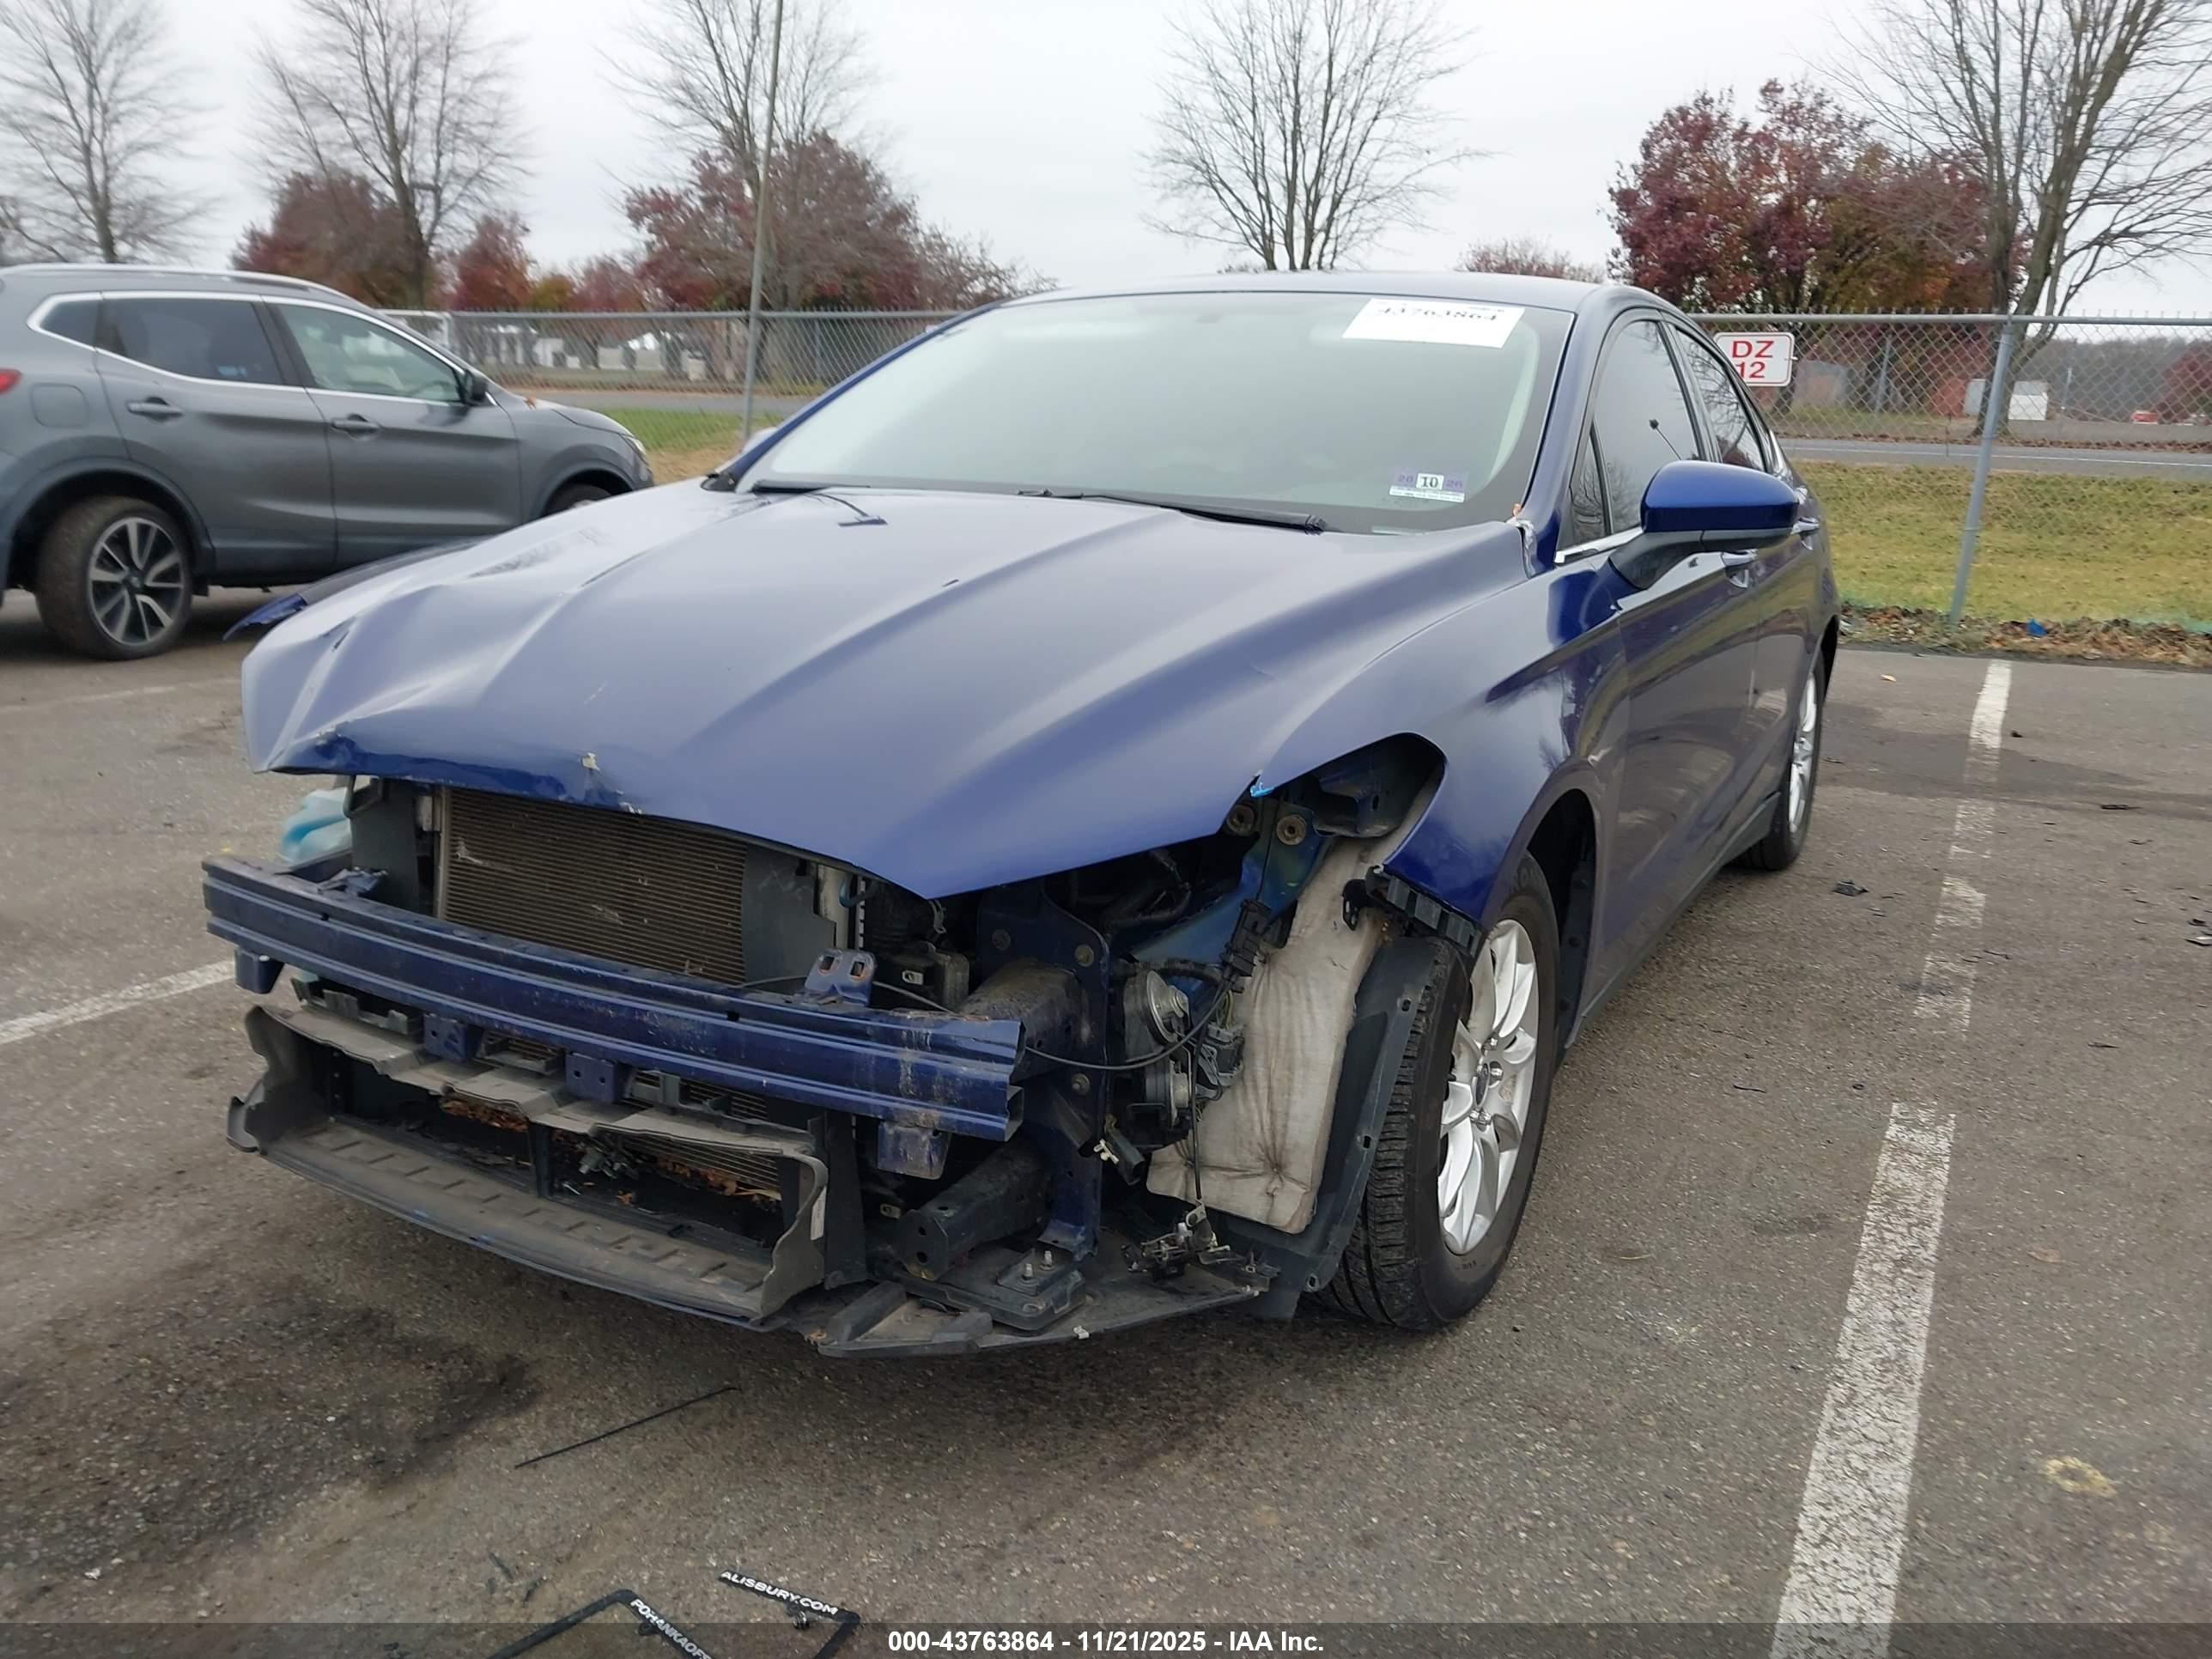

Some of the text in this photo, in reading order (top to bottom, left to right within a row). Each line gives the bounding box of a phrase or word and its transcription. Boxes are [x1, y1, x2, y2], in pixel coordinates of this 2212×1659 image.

[1731, 340, 1775, 359] DZ
[1735, 361, 1766, 379] 12
[1420, 476, 1439, 488] 10
